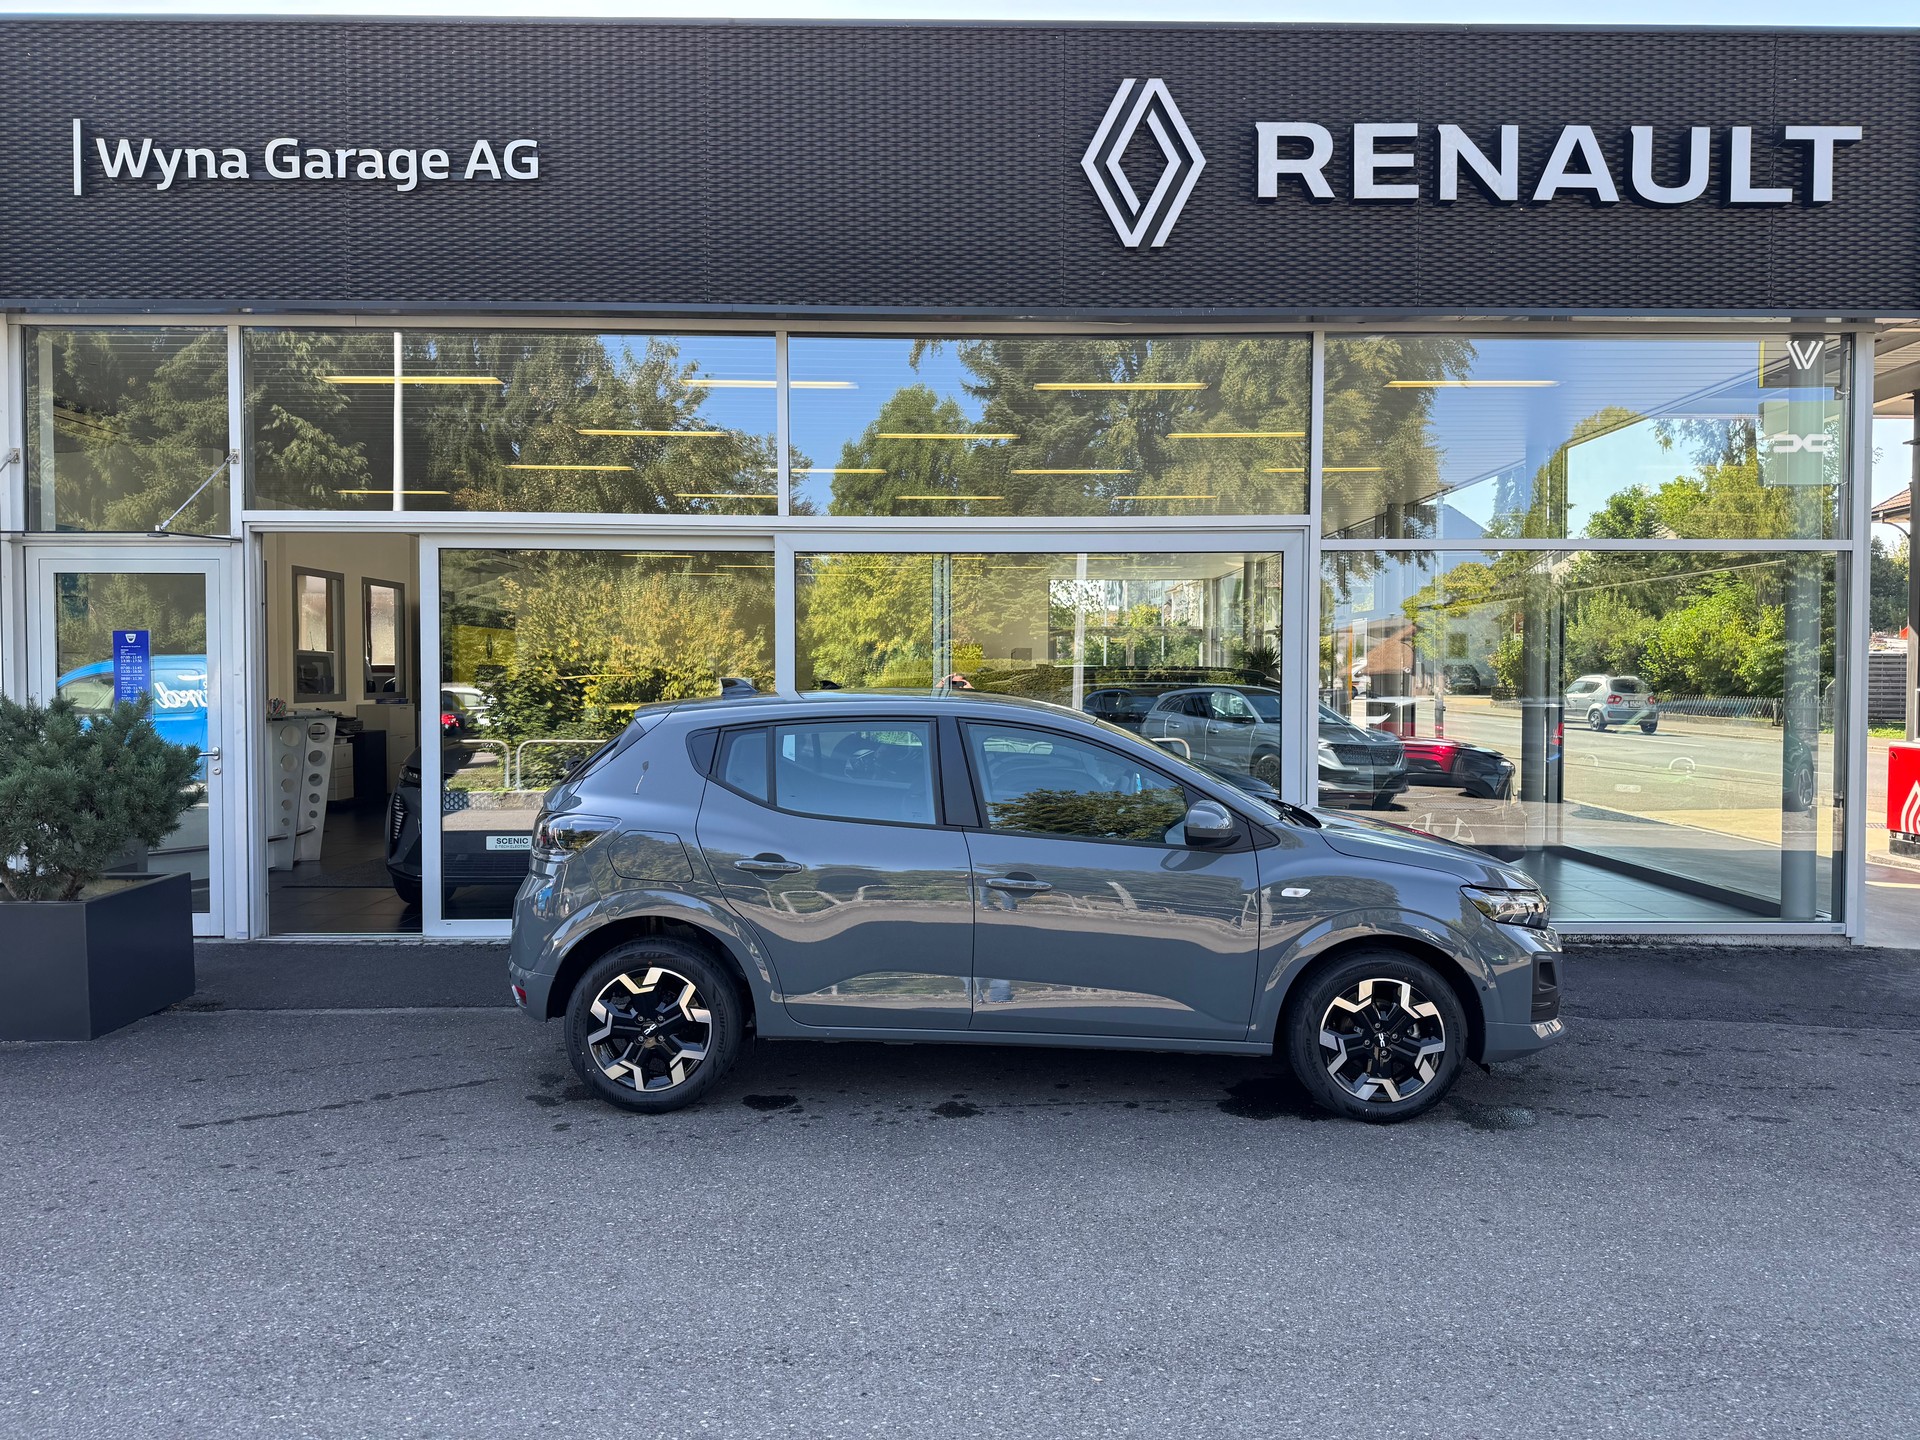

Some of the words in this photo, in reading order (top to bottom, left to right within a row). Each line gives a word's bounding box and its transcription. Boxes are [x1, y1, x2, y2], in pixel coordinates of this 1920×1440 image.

[95, 138, 250, 191] Wyna
[264, 138, 450, 192] Garage
[463, 139, 539, 180] AG
[1255, 121, 1863, 205] RENAULT
